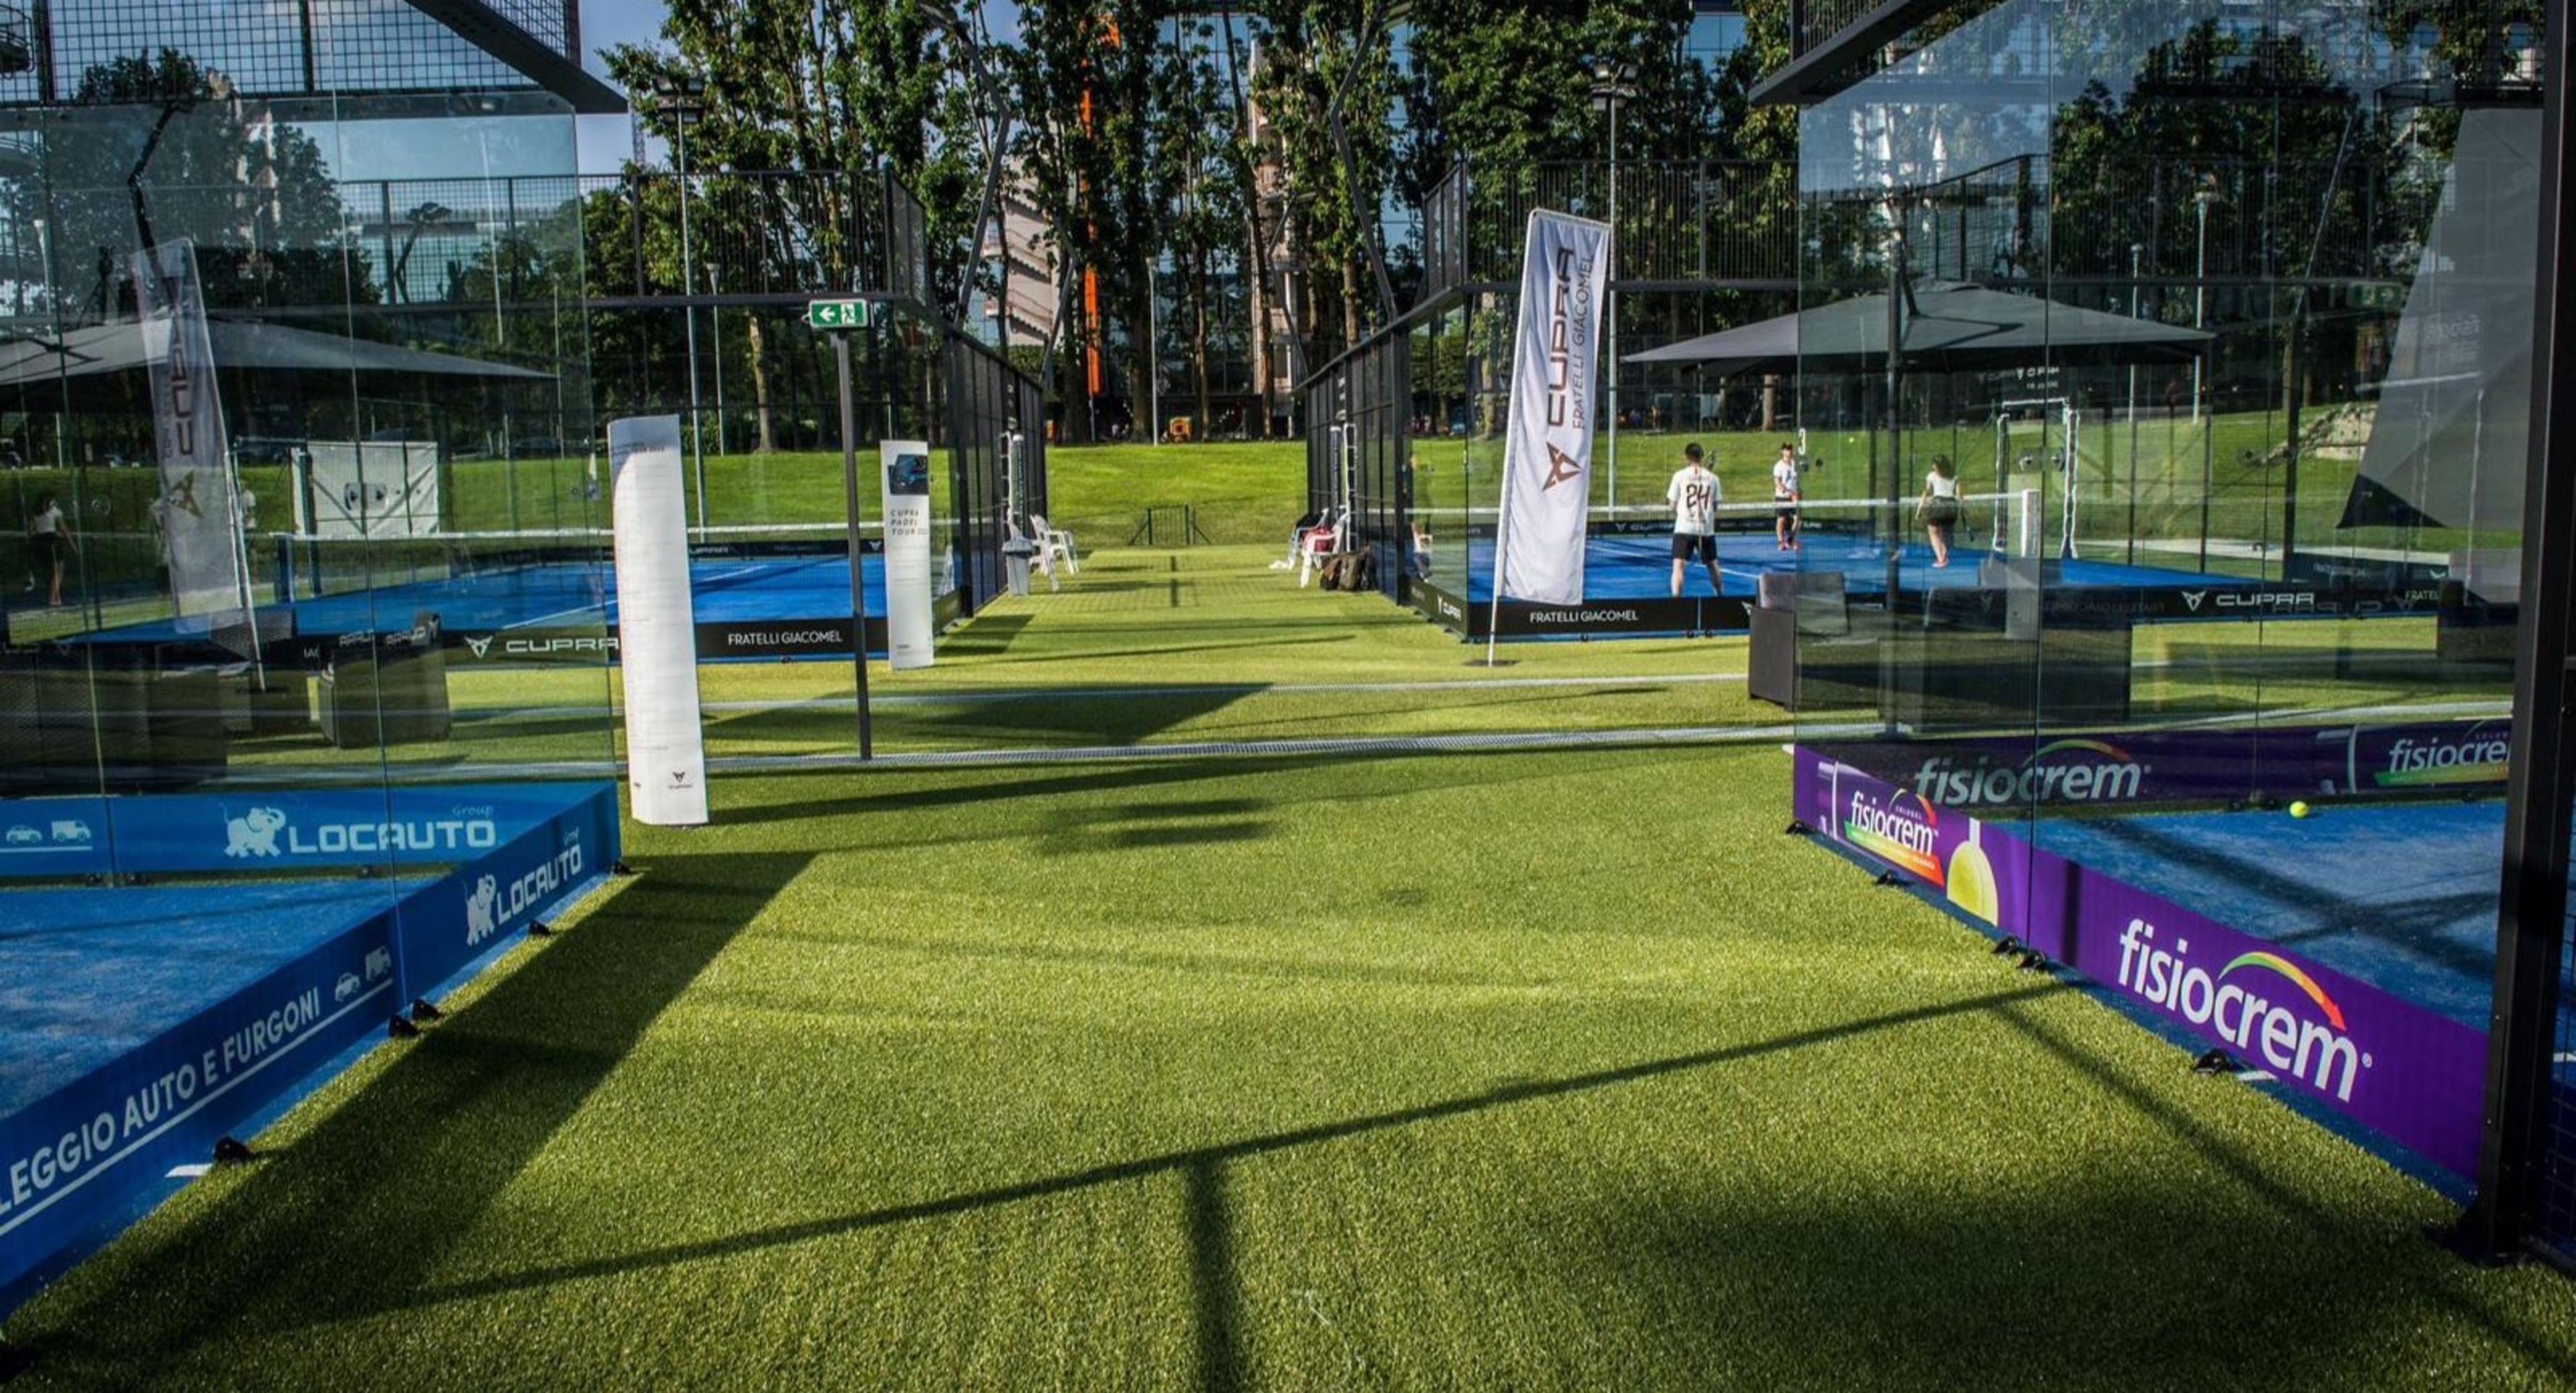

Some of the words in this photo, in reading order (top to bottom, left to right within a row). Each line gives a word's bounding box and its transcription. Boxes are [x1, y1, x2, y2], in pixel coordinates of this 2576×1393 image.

[1572, 255, 1595, 346] GIACOMEL
[1547, 247, 1574, 427] CUPRA
[1572, 354, 1586, 429] FRATELLI
[1798, 428, 1806, 455] 3
[1686, 484, 1711, 510] 24
[2216, 592, 2315, 606] CUPRA
[1529, 611, 1577, 623] FRATELLI
[1580, 610, 1639, 621] GIACOMEL
[506, 638, 619, 652] CUPRA
[728, 633, 780, 646] FRATELLI
[781, 631, 843, 644] GIACOMEL
[2390, 737, 2511, 773] fisiocre
[290, 820, 496, 854] LOCAUTO
[498, 843, 582, 925] LOCAUTO
[123, 1063, 197, 1138] AUTO
[203, 1049, 219, 1086] E
[222, 986, 321, 1074] FURGONI
